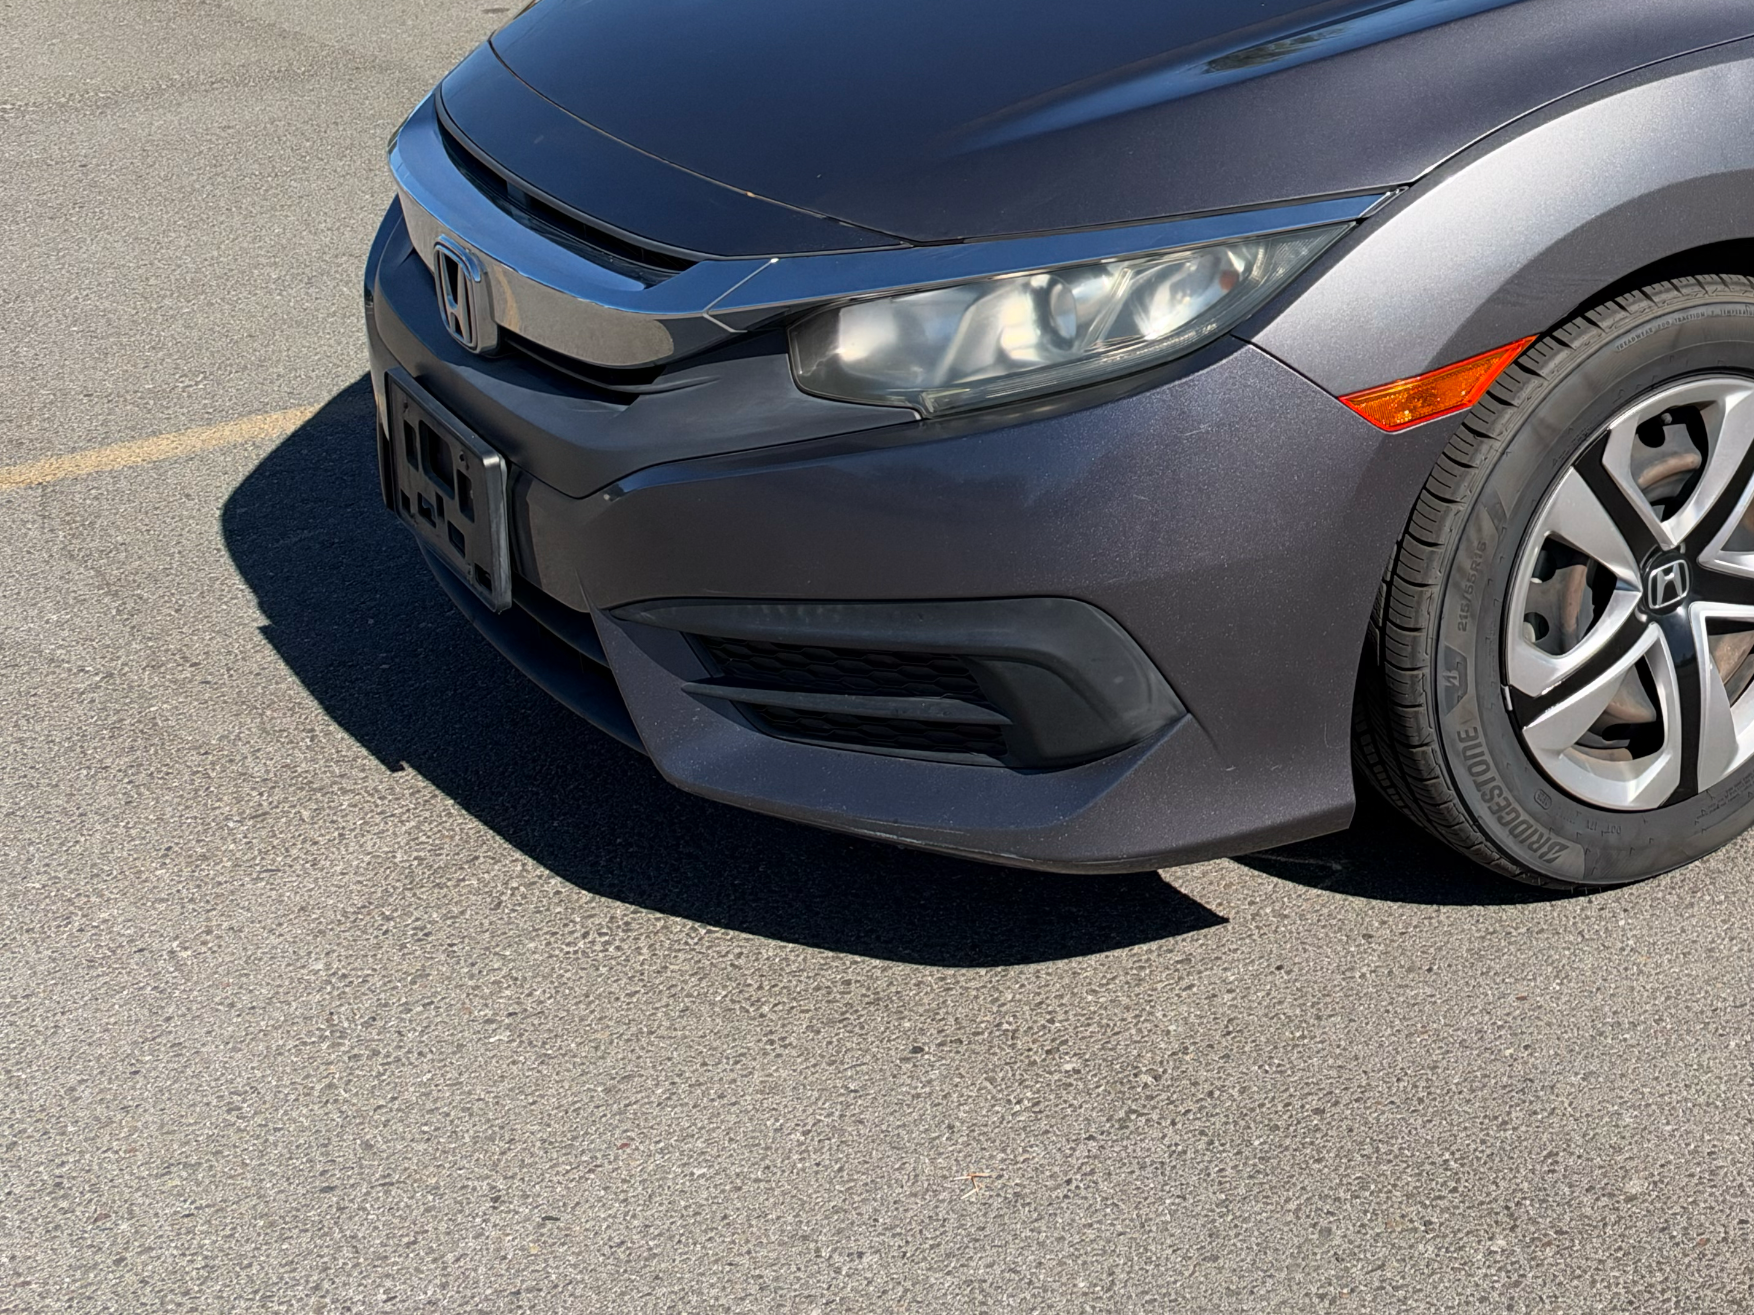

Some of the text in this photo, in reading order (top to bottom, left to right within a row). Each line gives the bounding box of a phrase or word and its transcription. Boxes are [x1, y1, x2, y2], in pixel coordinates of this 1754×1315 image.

[1616, 326, 1654, 351] TREADWEAR
[1457, 540, 1488, 633] 215/55R16
[1457, 726, 1570, 864] BRIDGESTONE
